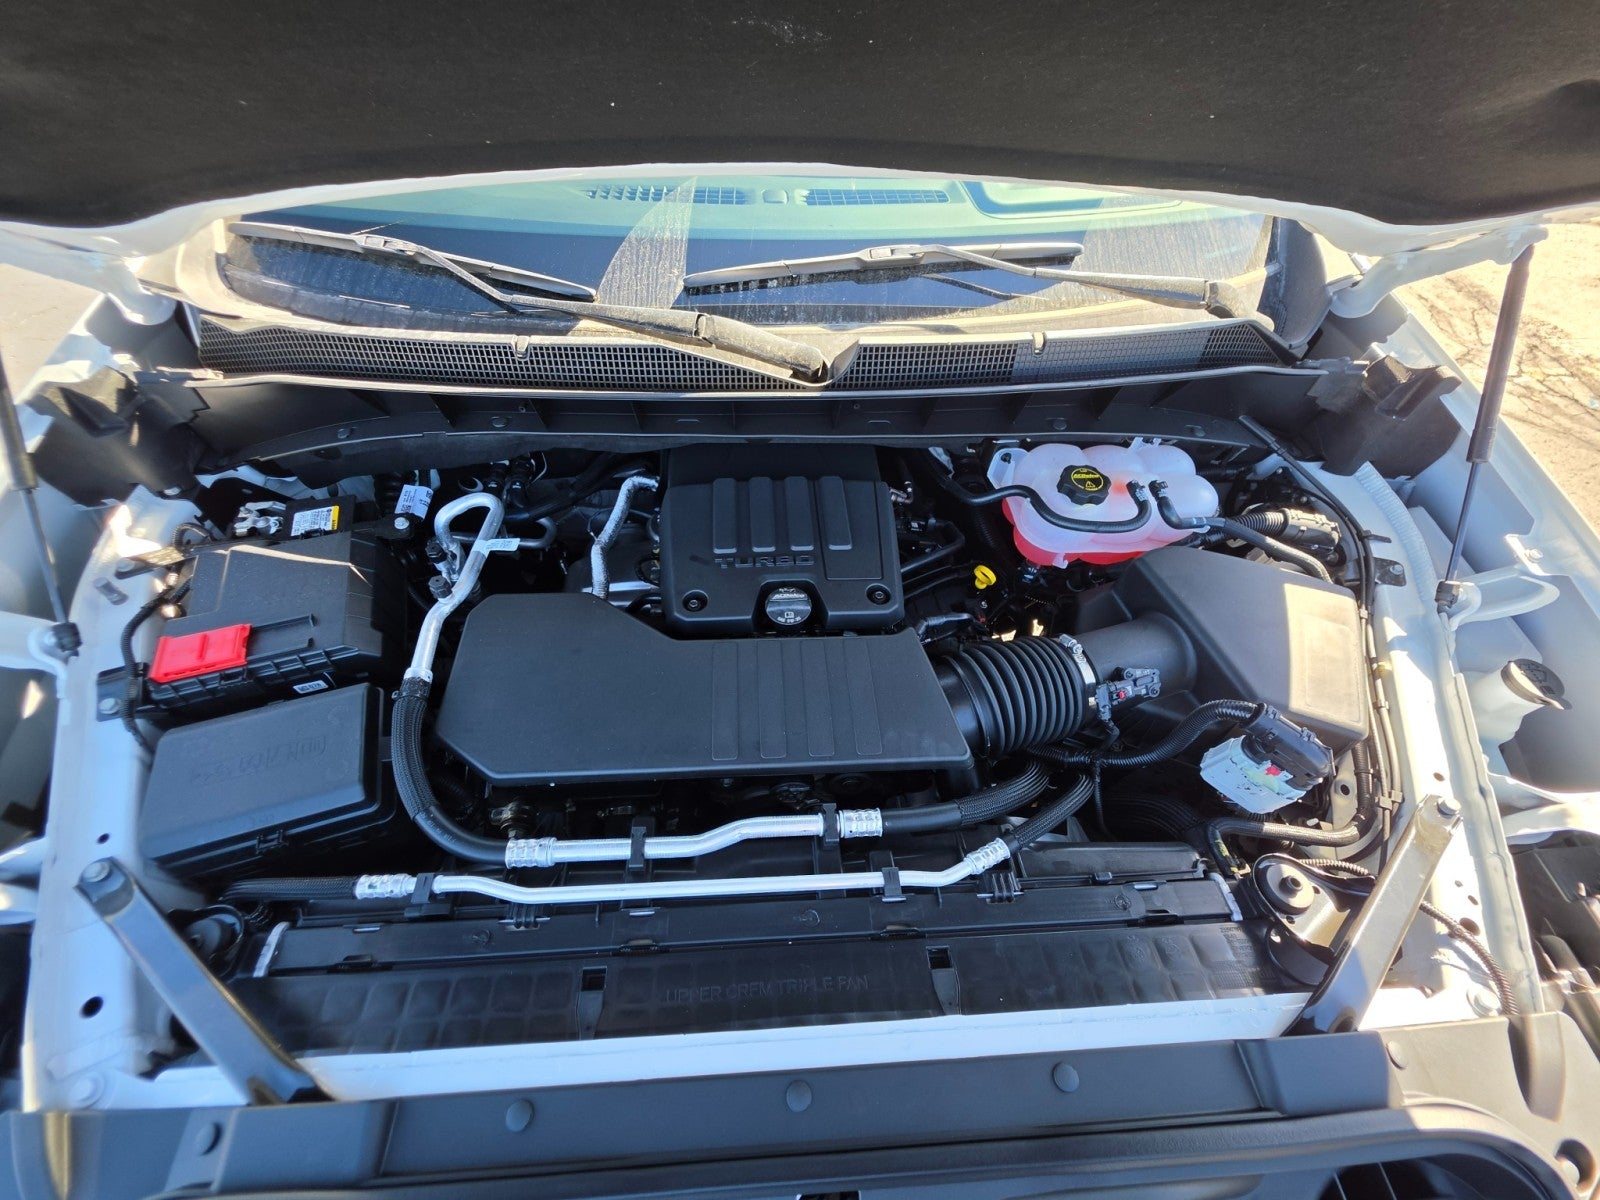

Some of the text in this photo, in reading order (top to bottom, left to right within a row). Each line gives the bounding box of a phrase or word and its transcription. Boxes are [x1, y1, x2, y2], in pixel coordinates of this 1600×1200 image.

[714, 555, 815, 569] TURBO
[666, 985, 722, 1003] UPPER
[837, 974, 869, 992] FAN
